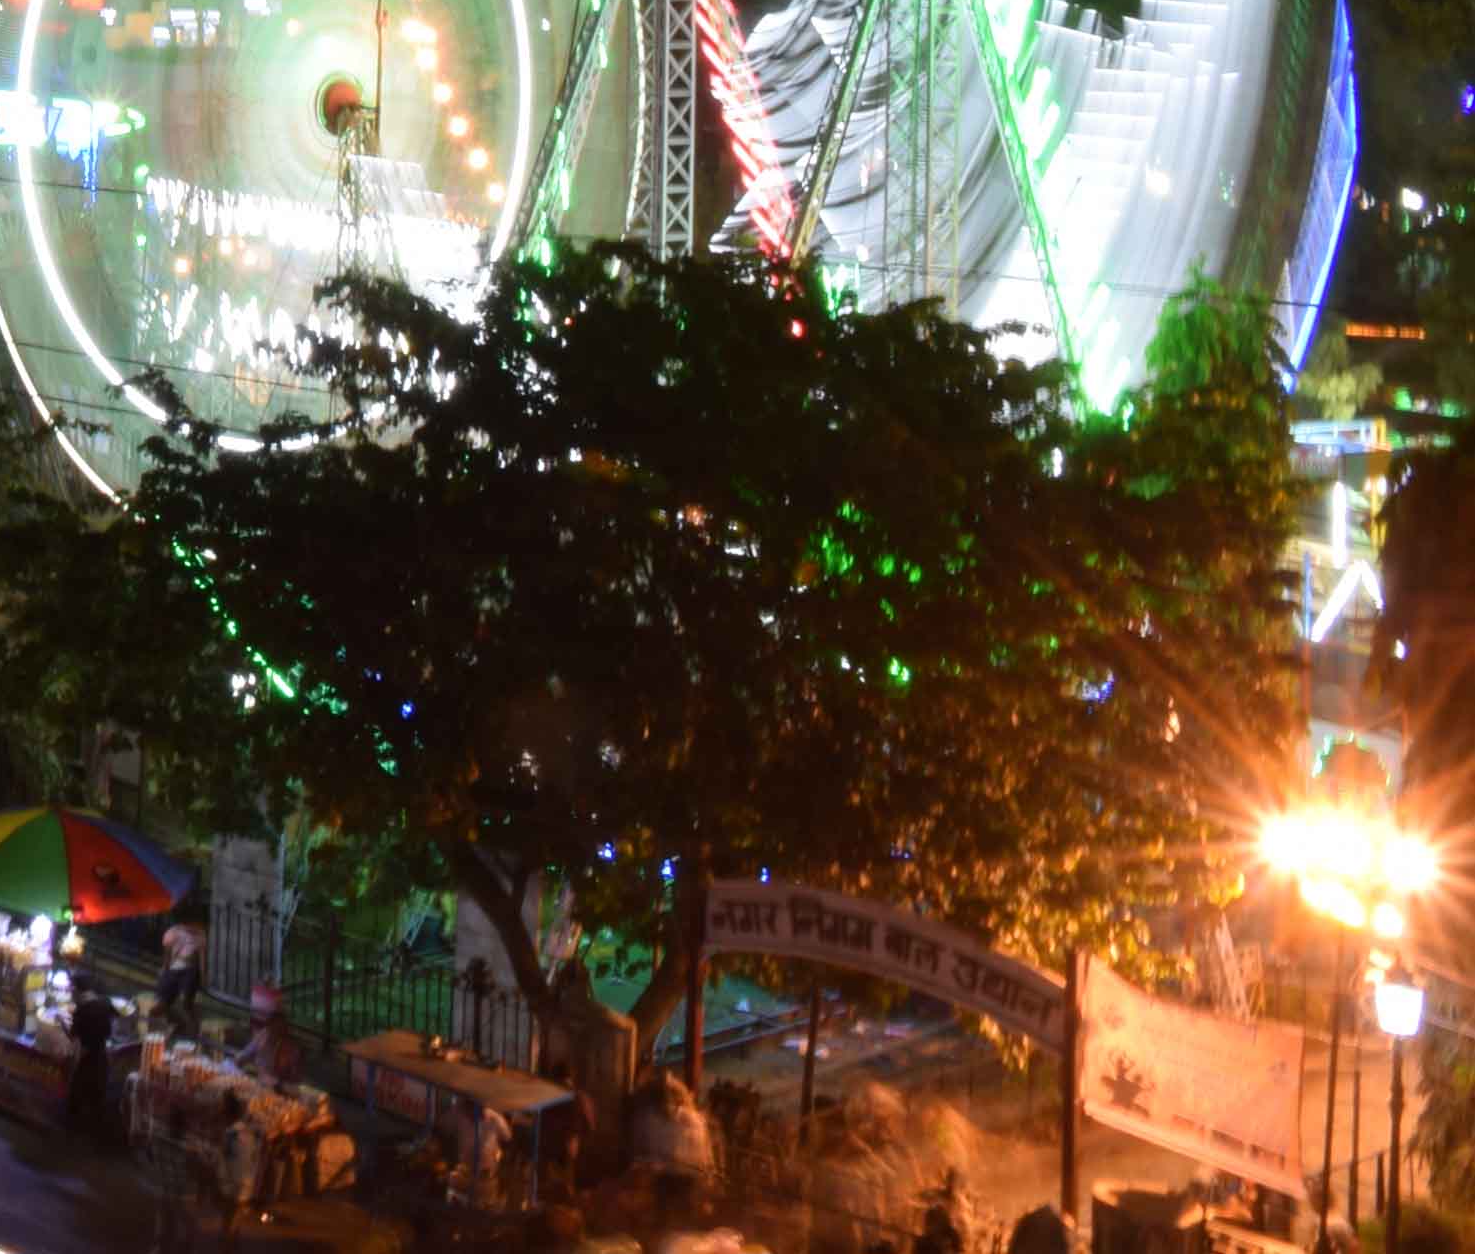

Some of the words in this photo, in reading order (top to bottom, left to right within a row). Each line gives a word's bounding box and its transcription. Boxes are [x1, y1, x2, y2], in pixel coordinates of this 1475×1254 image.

[711, 898, 783, 937] नगर
[788, 895, 879, 953] निगम
[883, 922, 949, 975] बाल
[951, 949, 1062, 1025] उद्यान
